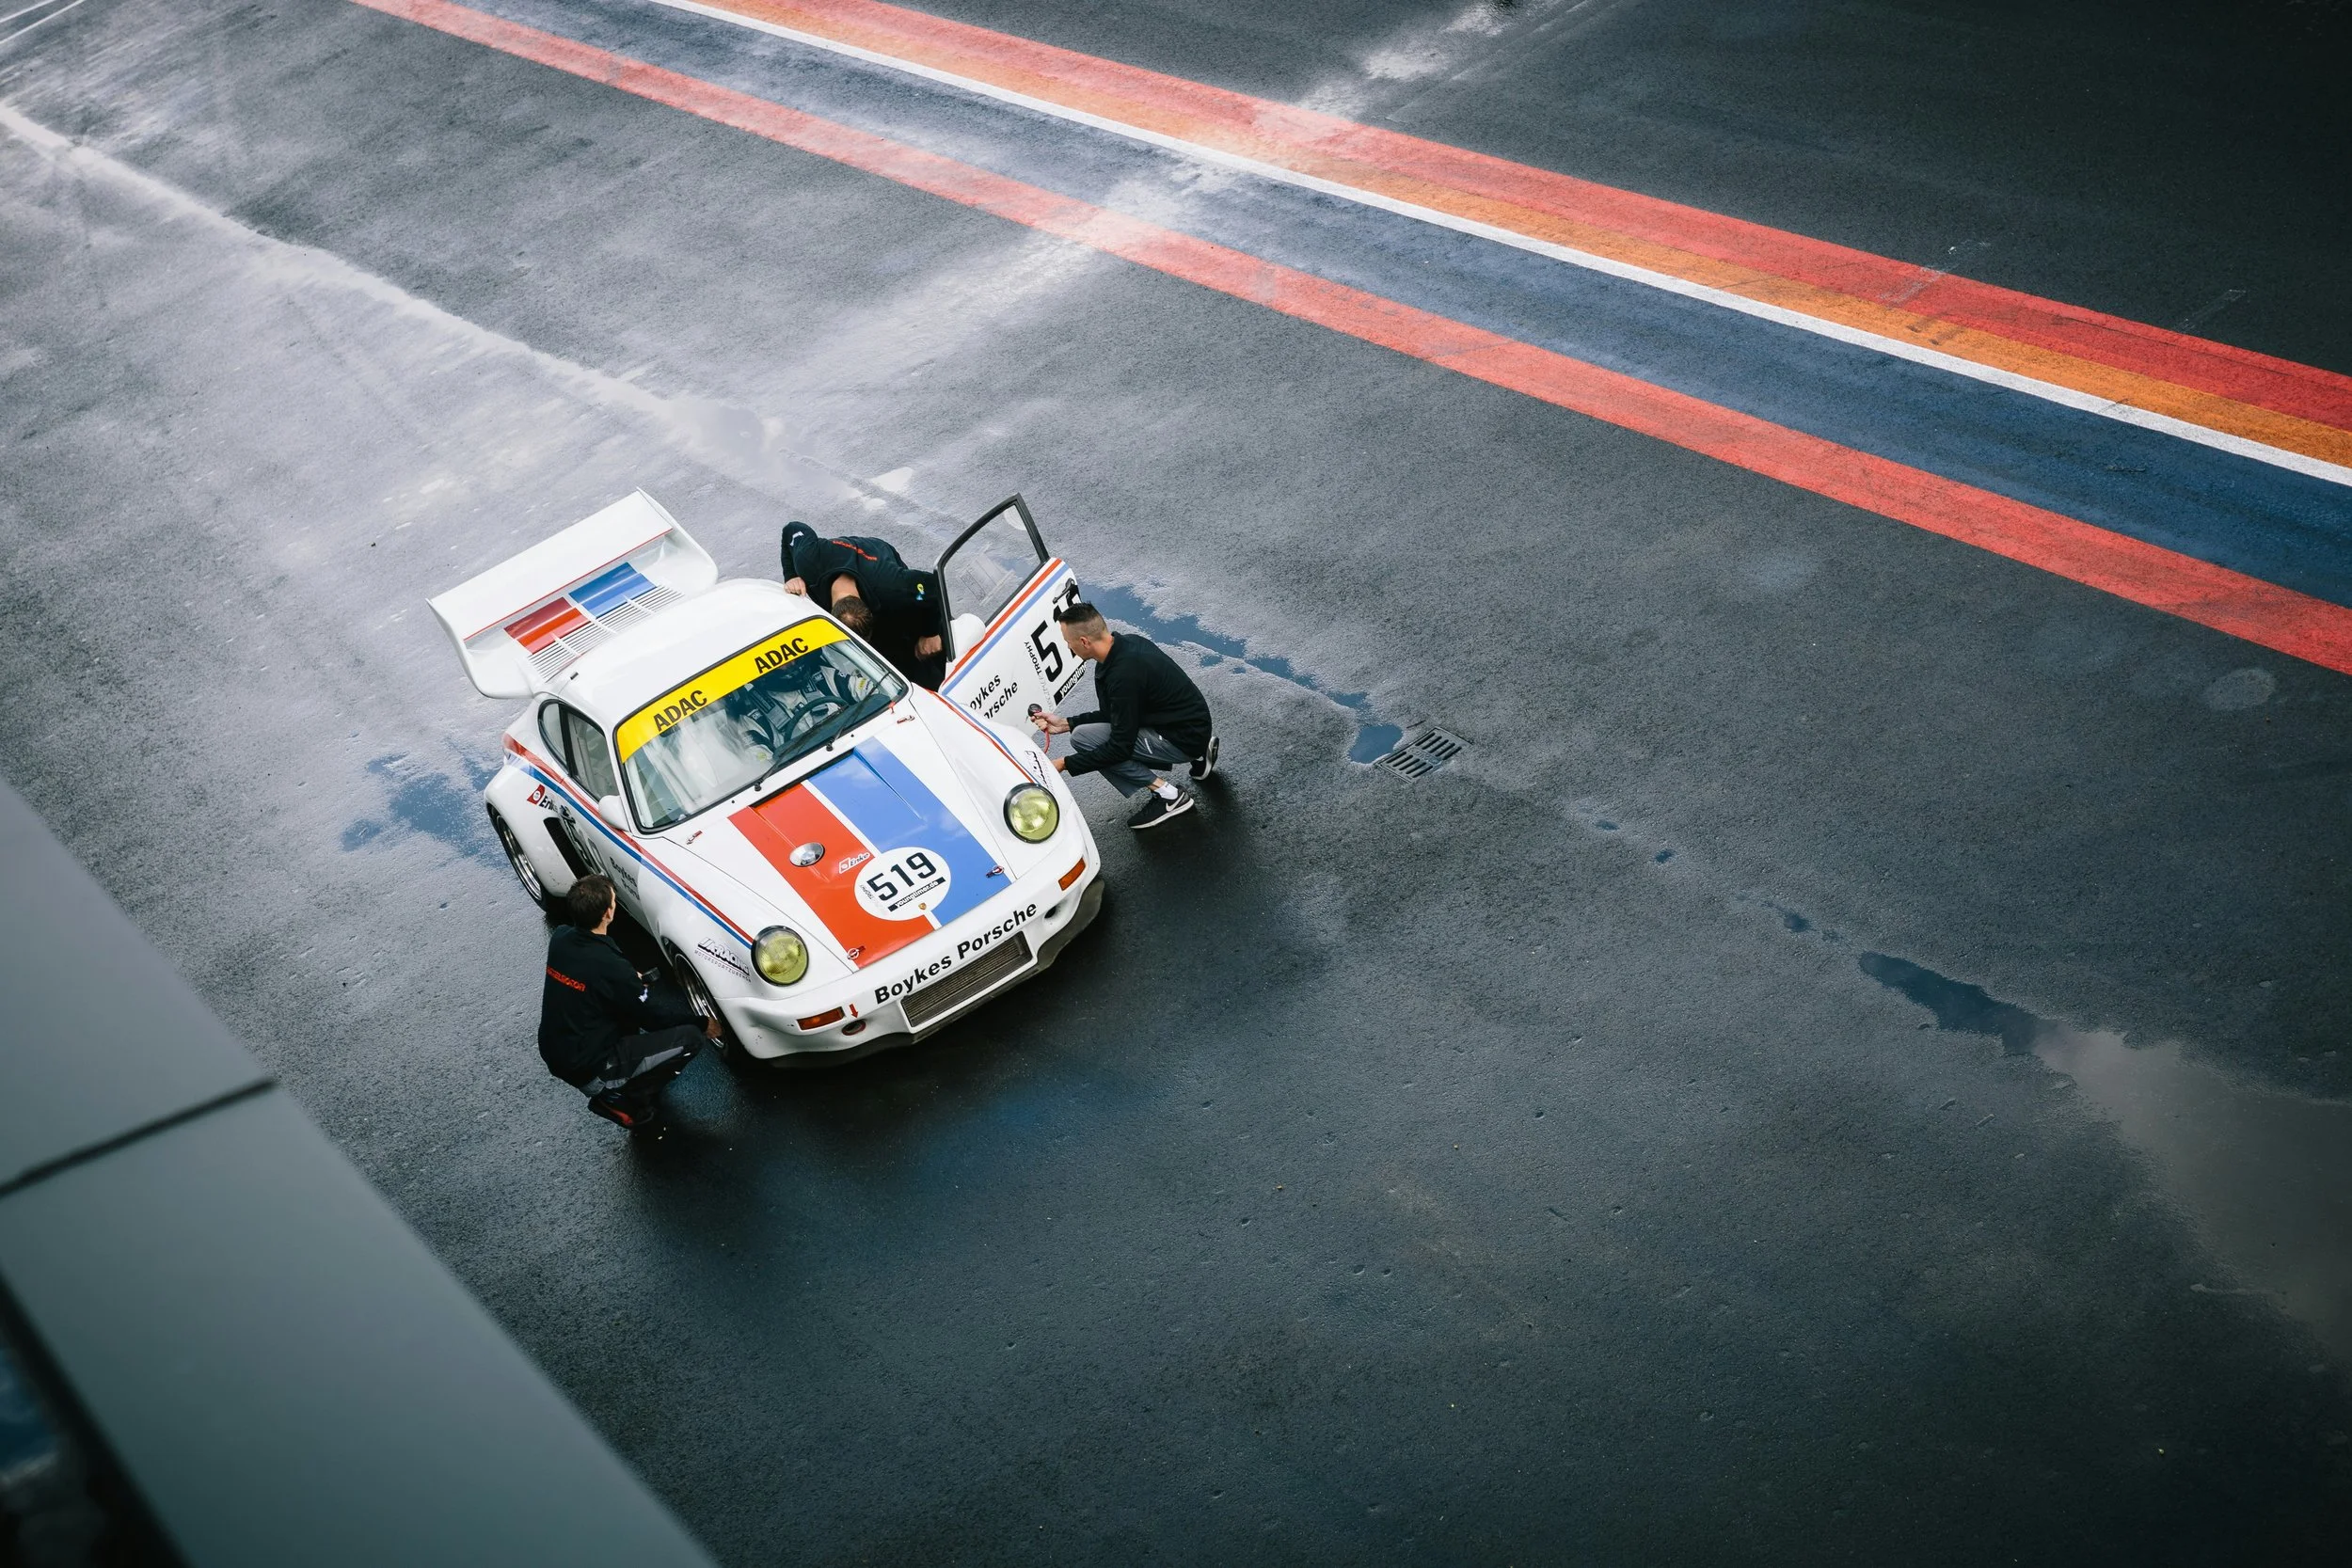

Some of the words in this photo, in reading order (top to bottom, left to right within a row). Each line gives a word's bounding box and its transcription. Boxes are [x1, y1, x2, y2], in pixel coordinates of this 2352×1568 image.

[755, 637, 809, 674] ADAC
[1024, 641, 1042, 675] TROPHY
[653, 689, 707, 732] ADAC
[970, 673, 1001, 711] oykes
[983, 681, 1018, 720] orsche
[866, 852, 937, 901] 519
[895, 880, 939, 908] youngtimer.de
[874, 955, 952, 1005] Boykes
[957, 903, 1037, 959] Porsche
